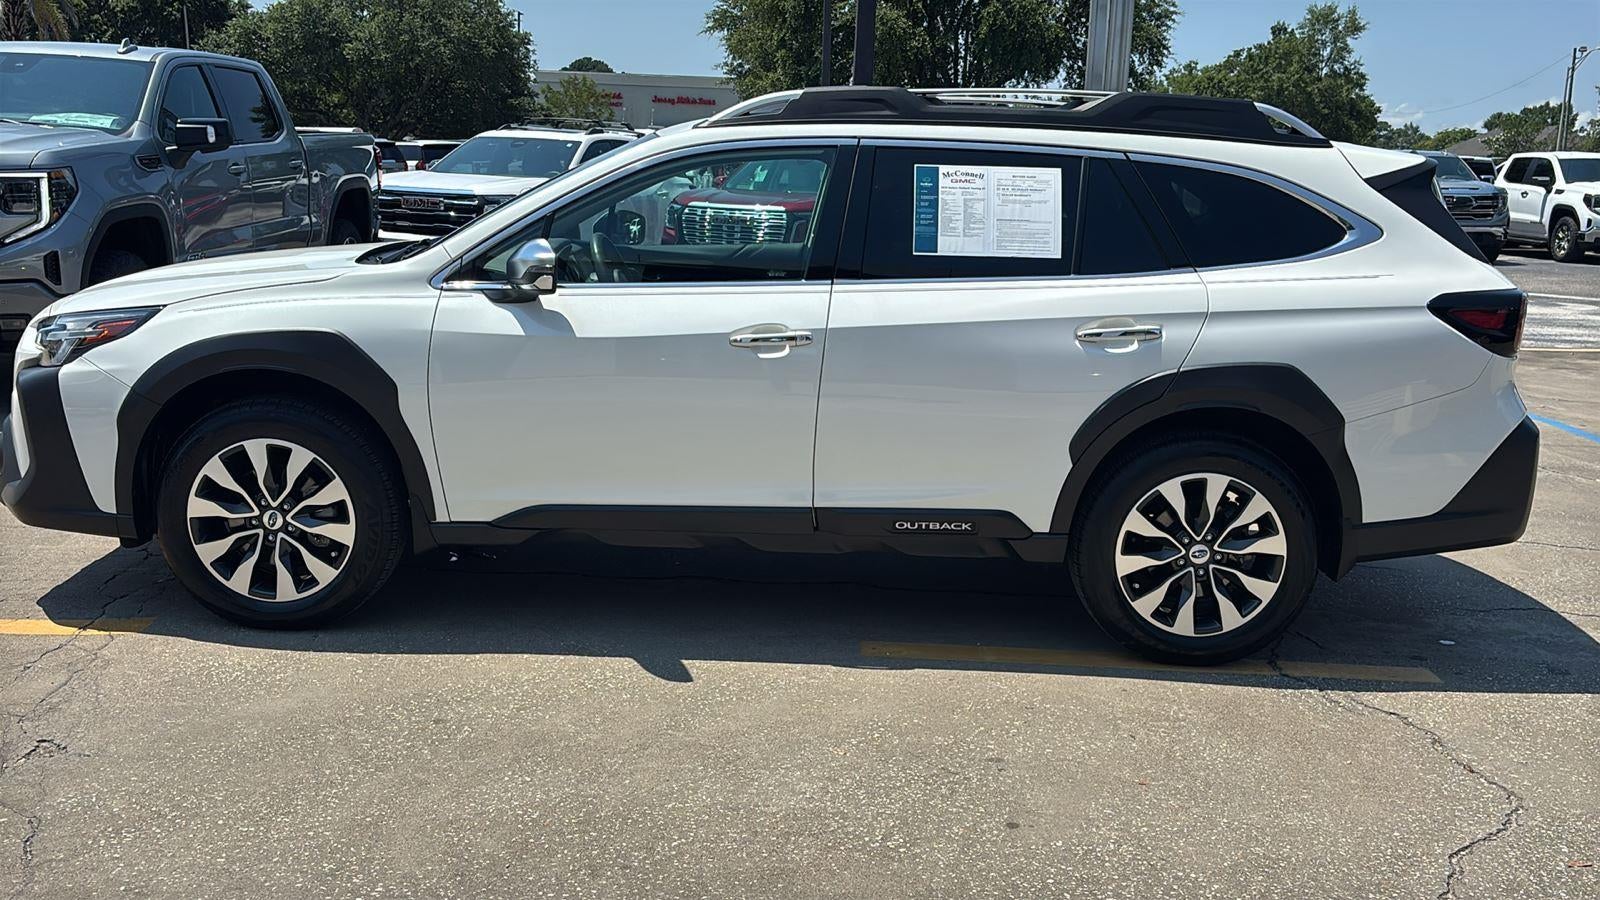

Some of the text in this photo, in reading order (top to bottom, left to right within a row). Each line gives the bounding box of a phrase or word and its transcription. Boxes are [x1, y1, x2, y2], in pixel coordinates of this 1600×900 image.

[942, 169, 985, 180] McConnell
[402, 196, 443, 210] GMC
[895, 521, 973, 531] OUTBACK
